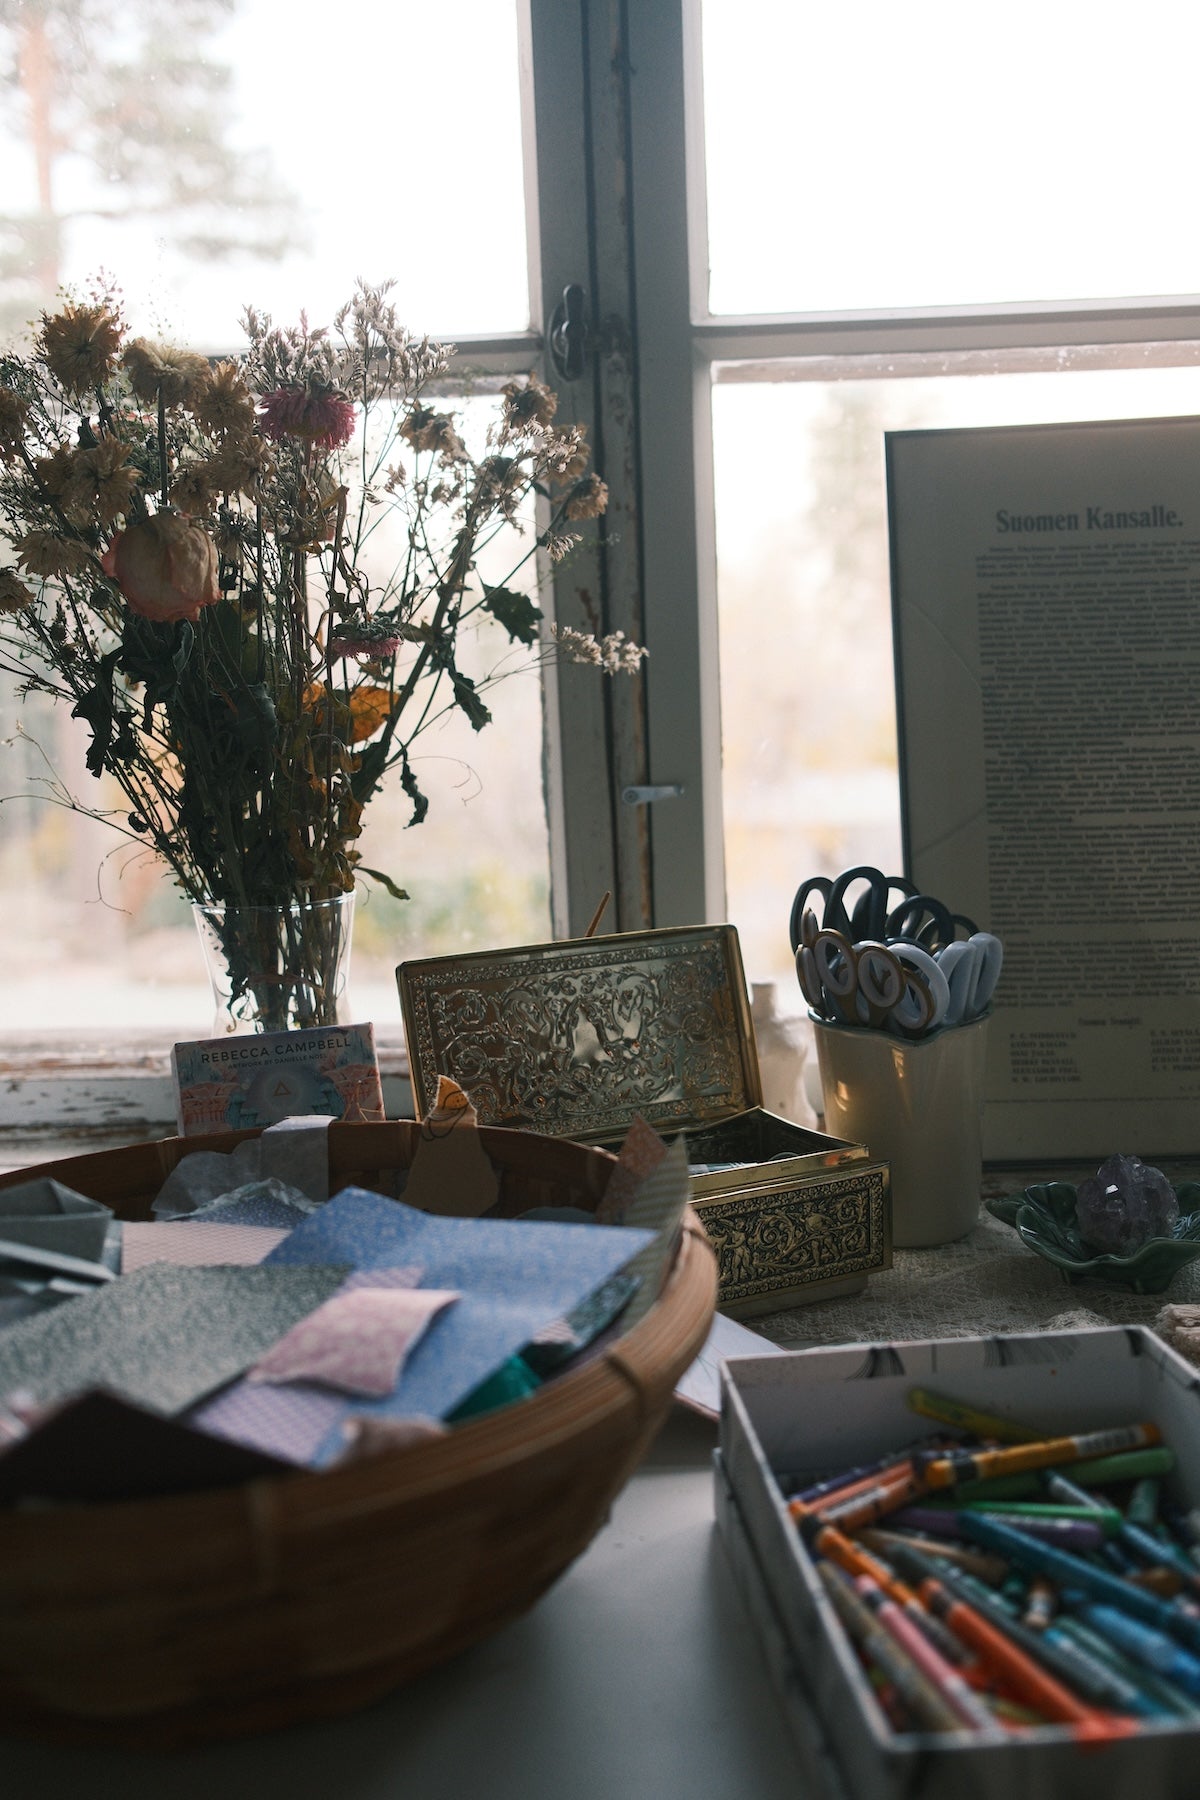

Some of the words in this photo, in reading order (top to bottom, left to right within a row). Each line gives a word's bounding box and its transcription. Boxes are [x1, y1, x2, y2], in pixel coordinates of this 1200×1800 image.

[996, 509, 1079, 533] Suomen
[1086, 505, 1184, 530] Kansalle.
[201, 1047, 270, 1064] REBECCA
[275, 1038, 351, 1055] CAMPBELL
[228, 1060, 262, 1070] ARTWORK
[274, 1054, 307, 1064] DANIELLE
